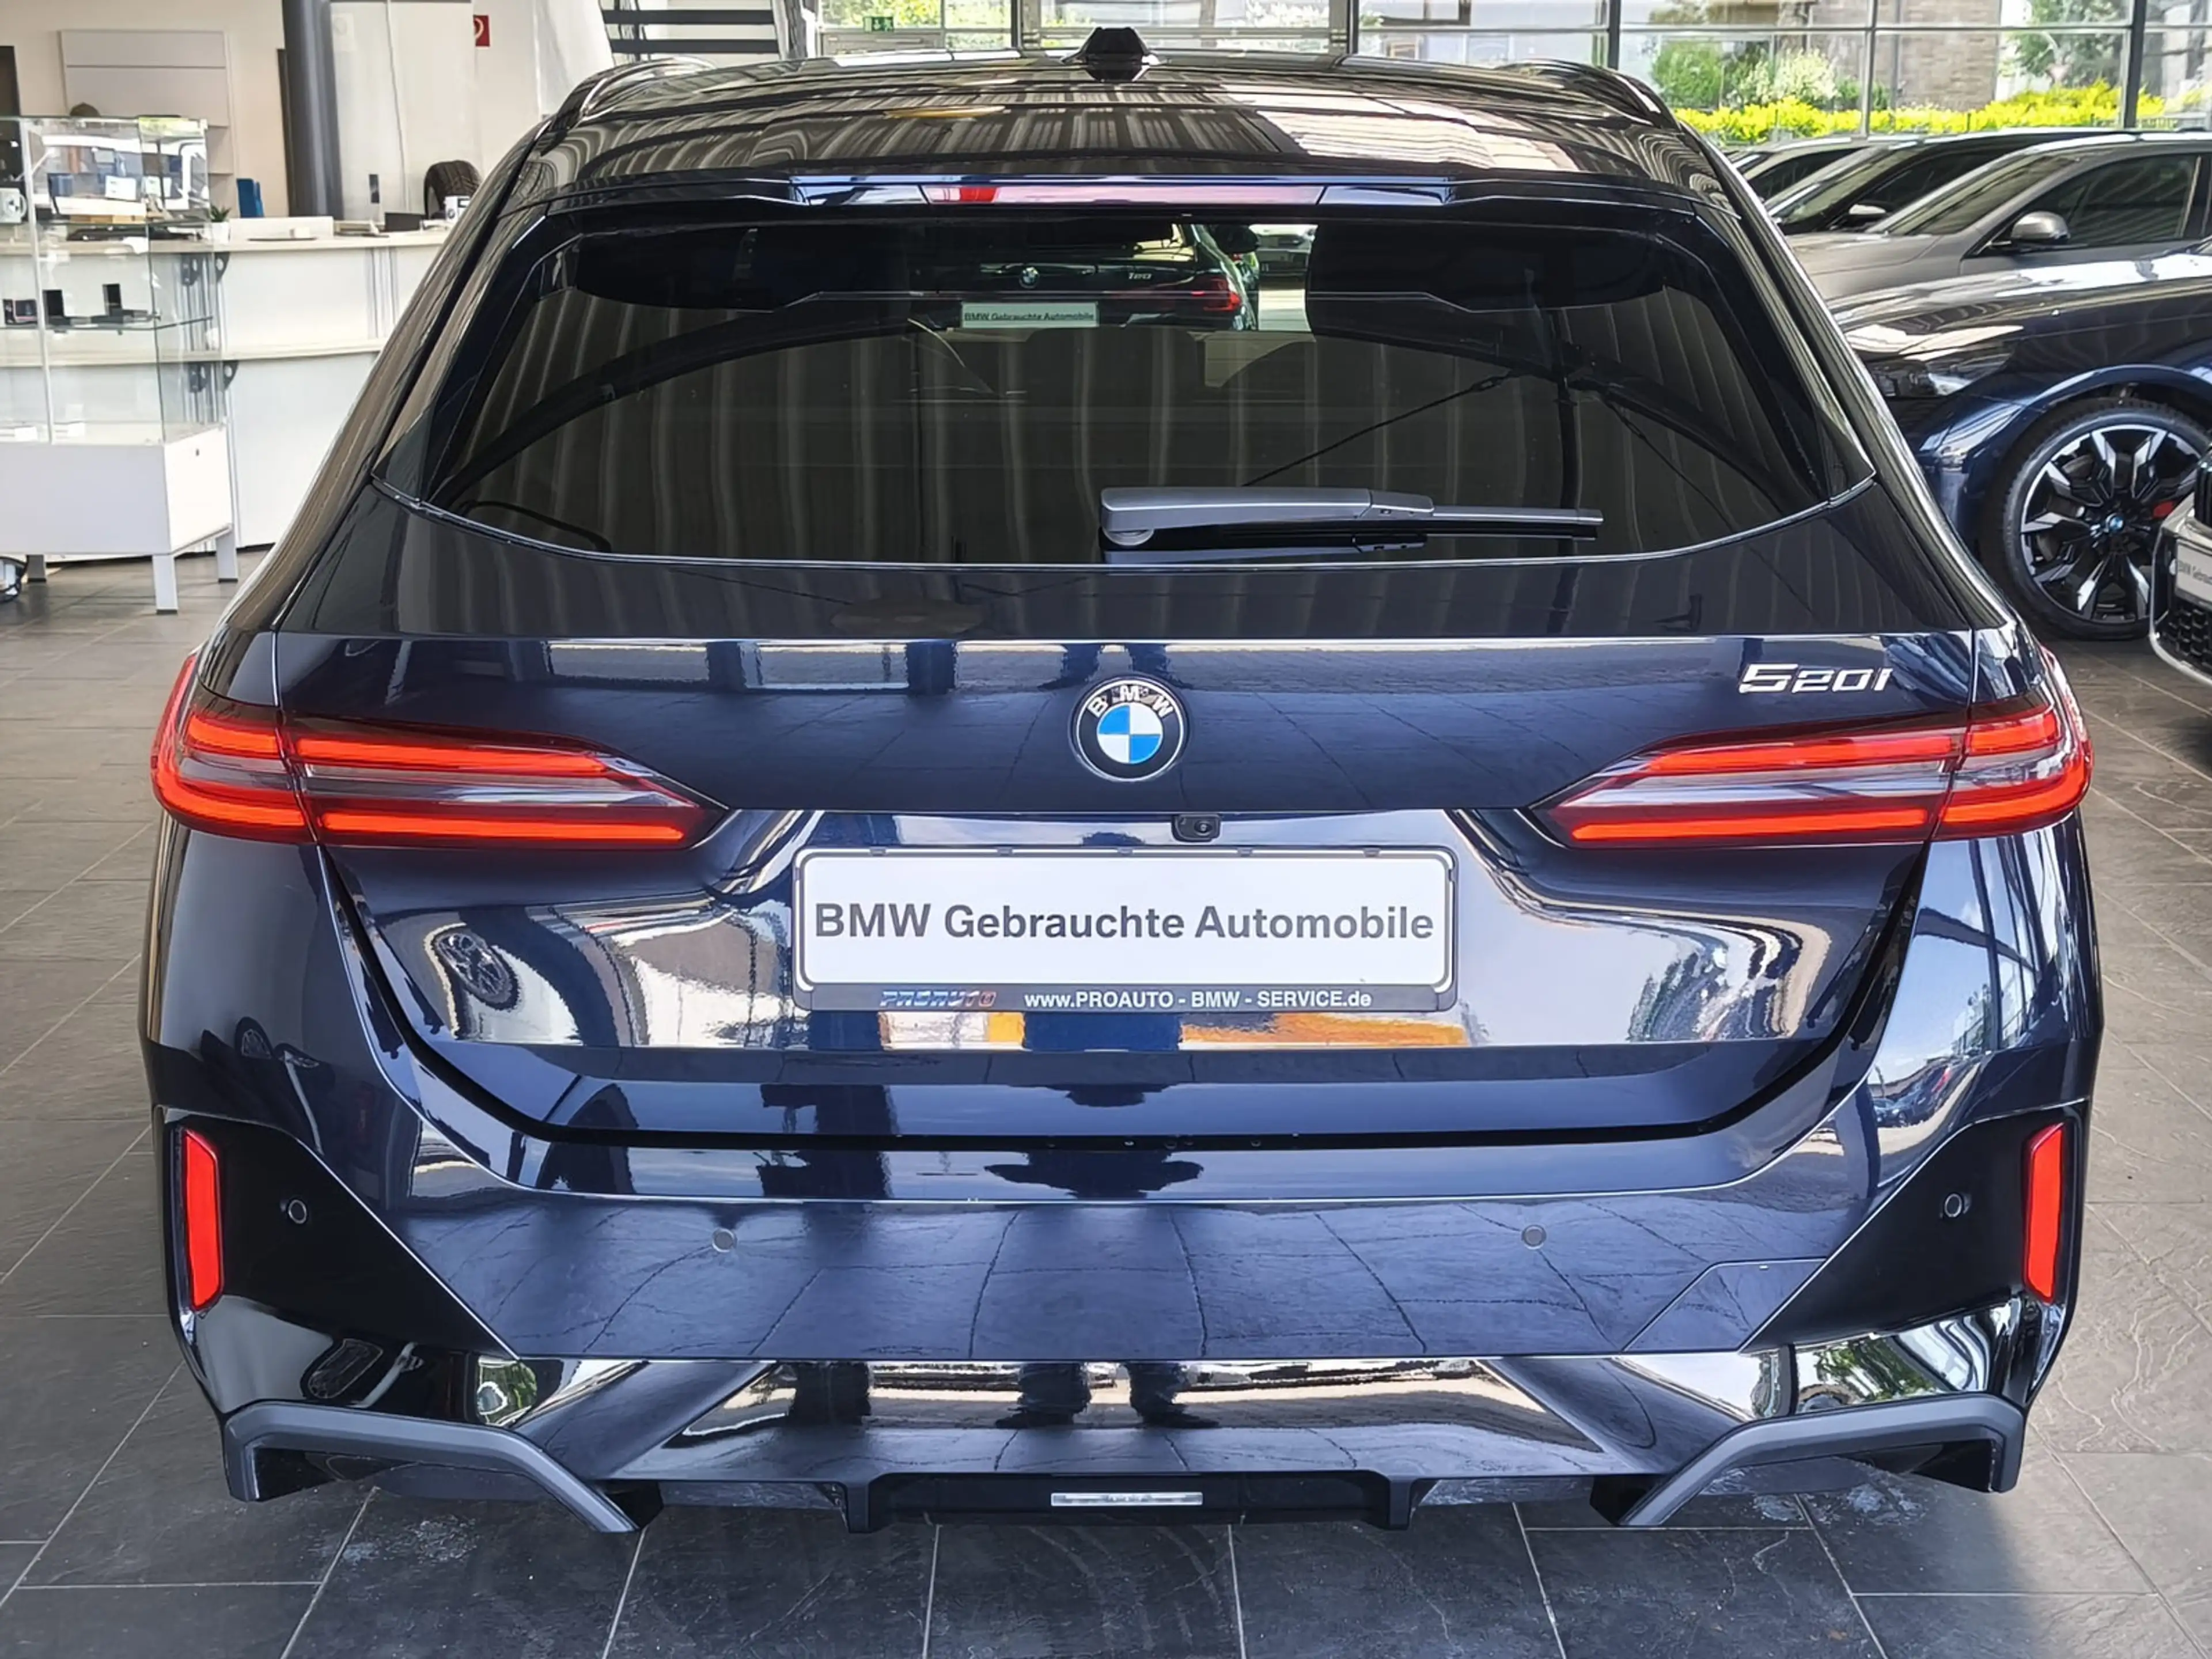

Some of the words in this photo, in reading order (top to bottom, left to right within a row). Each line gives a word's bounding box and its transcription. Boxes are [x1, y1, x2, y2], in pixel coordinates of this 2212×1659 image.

[964, 312, 990, 321] BMW
[1738, 663, 1893, 694] 520i
[1086, 685, 1174, 718] BMW
[815, 903, 931, 938] BMW
[944, 904, 1184, 938] Gebrauchte
[1195, 906, 1434, 938] Automobile
[879, 990, 997, 1007] PROAUTO
[1191, 991, 1240, 1007] BMW
[1257, 990, 1372, 1007] SERVICE.de
